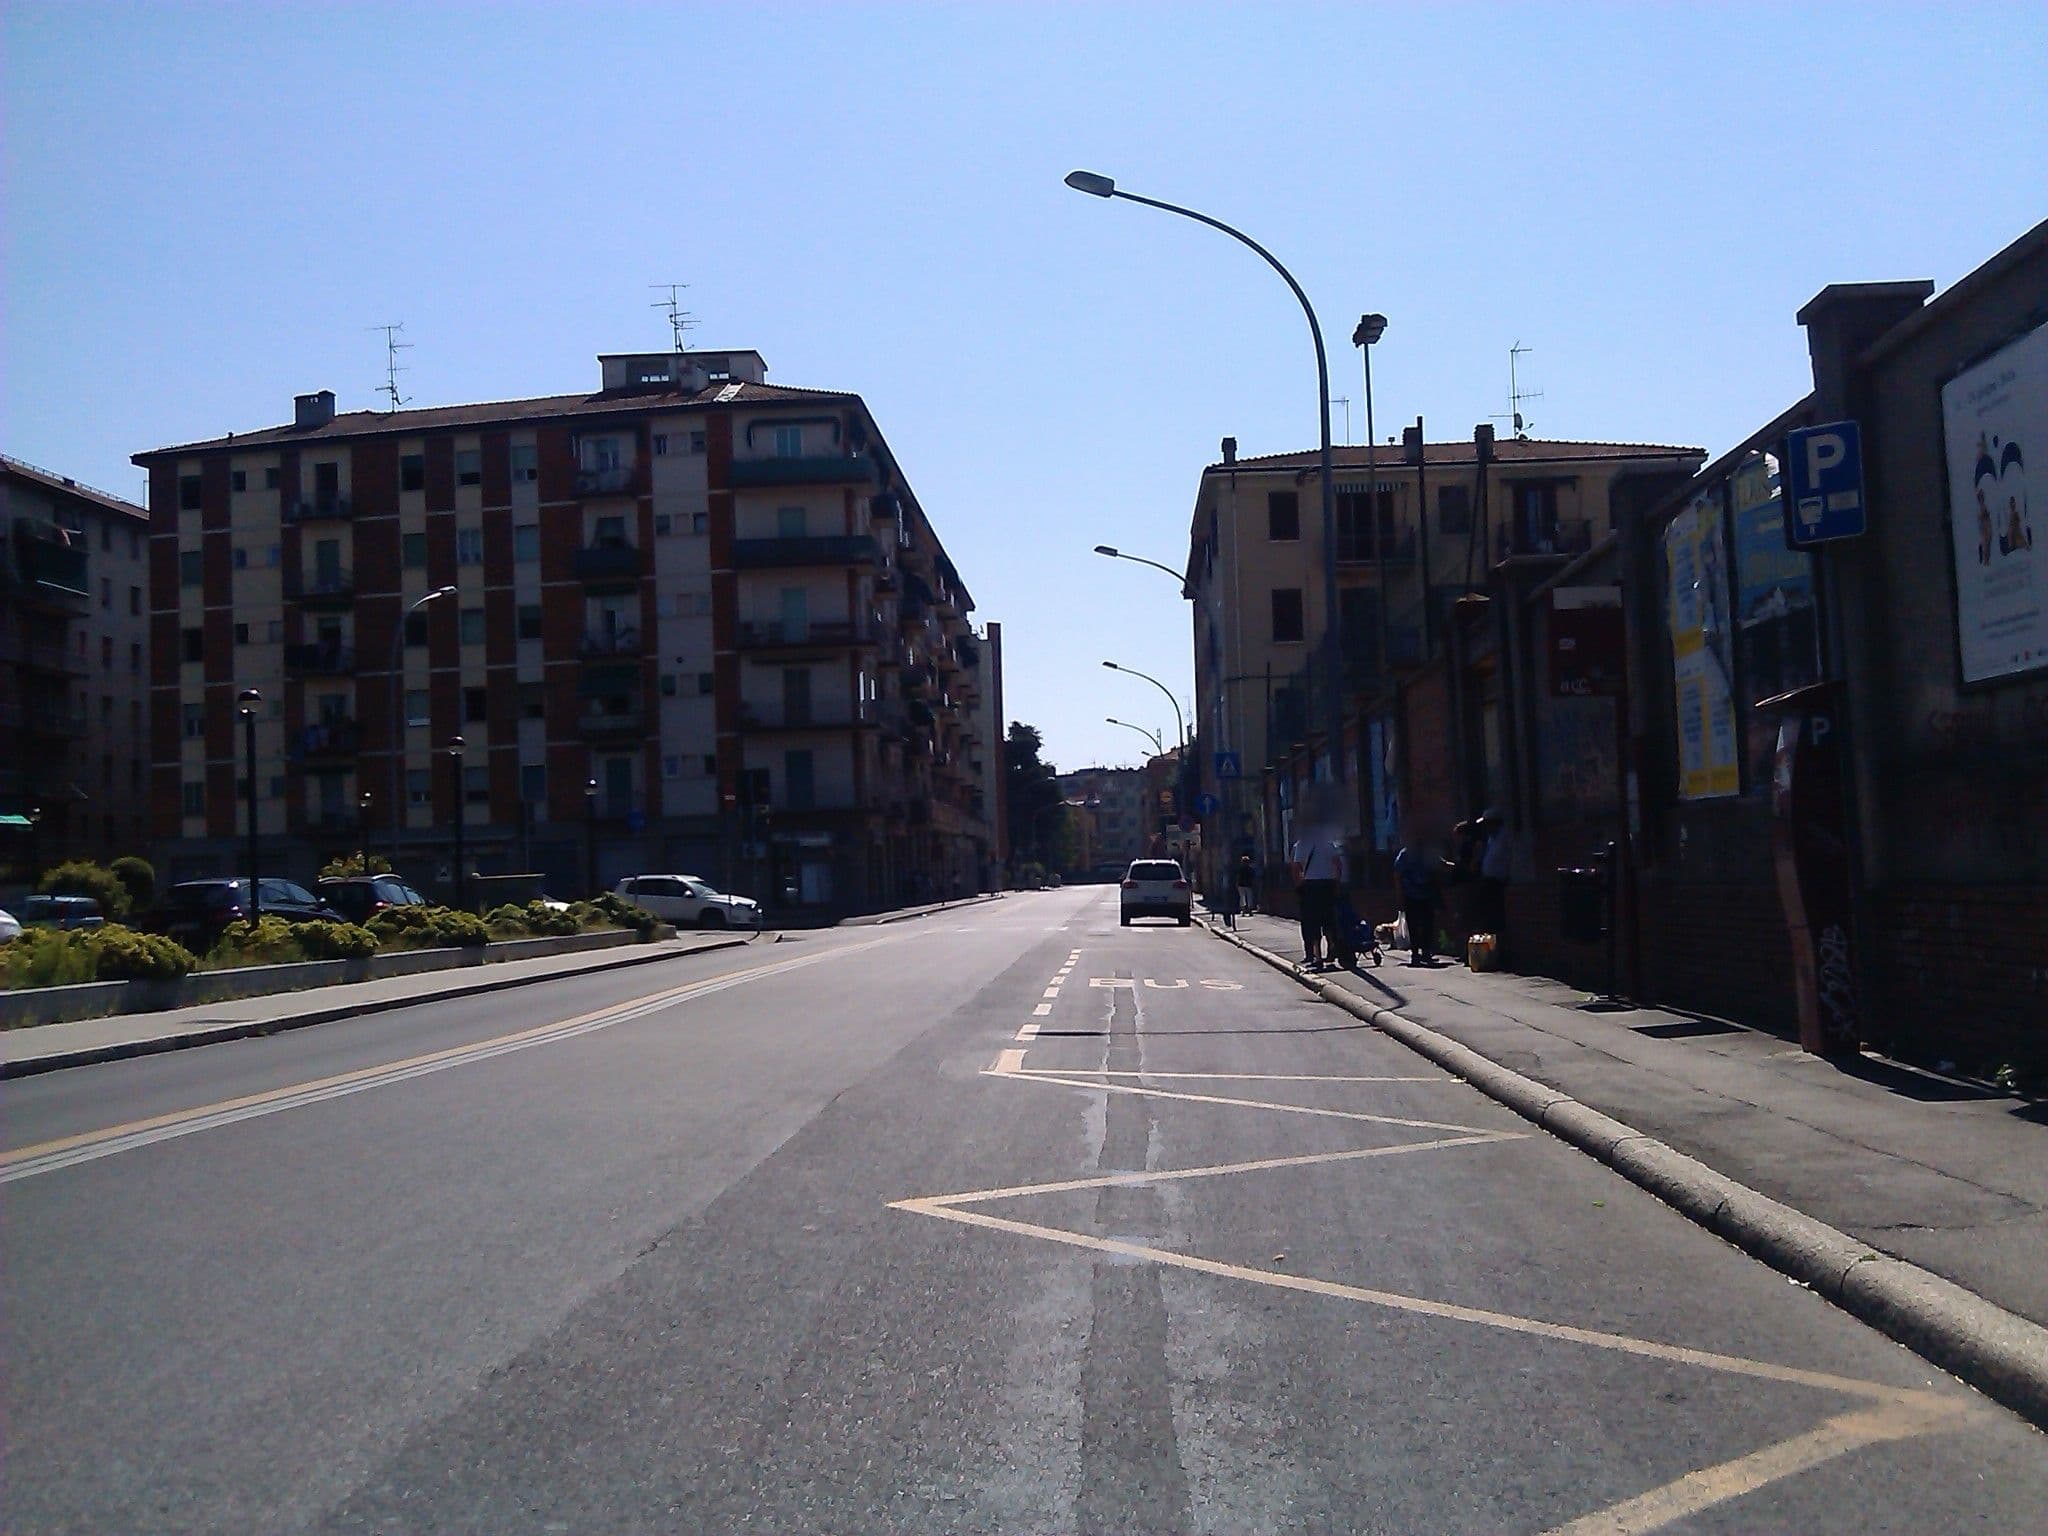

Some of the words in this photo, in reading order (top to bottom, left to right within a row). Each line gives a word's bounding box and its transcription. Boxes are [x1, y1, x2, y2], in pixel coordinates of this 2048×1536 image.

[1806, 433, 1845, 489] P
[1811, 716, 1831, 745] P
[1088, 977, 1244, 990] BUS
